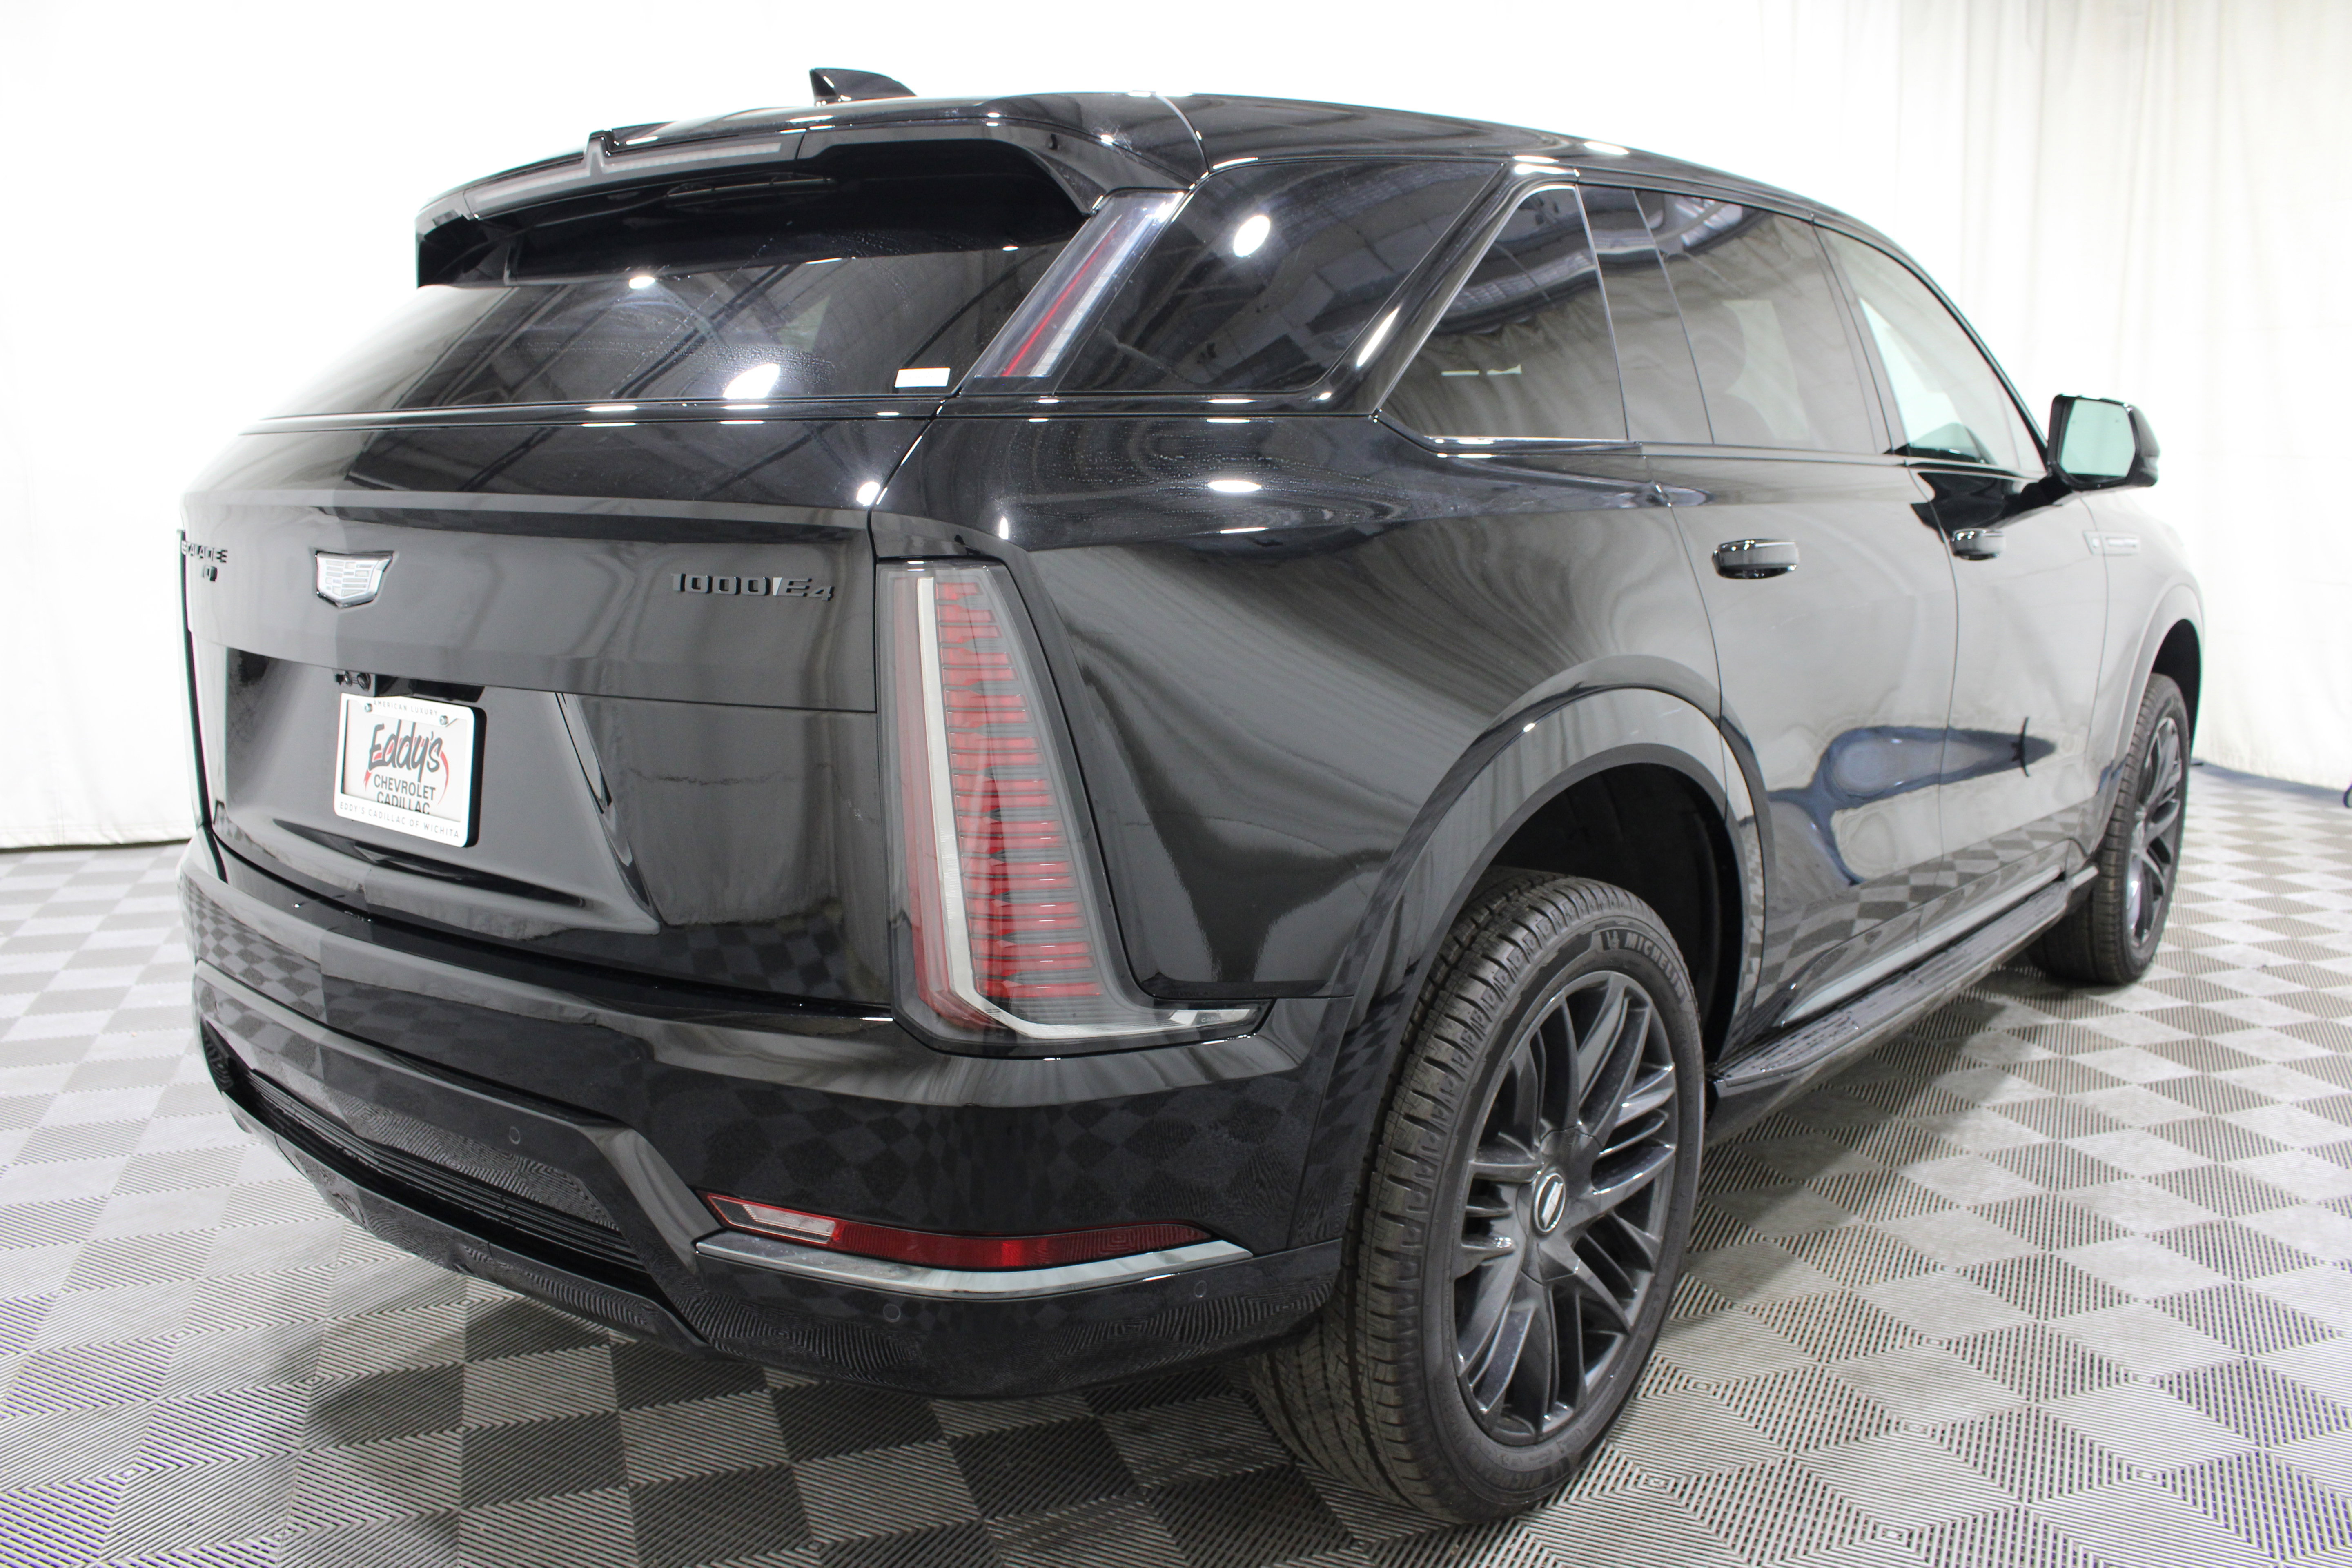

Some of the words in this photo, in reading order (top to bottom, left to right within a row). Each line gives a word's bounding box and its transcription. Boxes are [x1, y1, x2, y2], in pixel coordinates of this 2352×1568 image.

[374, 700, 407, 711] AMERICAN
[411, 706, 438, 716] LUXURY
[368, 719, 443, 782] Eddy's
[374, 774, 436, 800] CHEVROLET
[377, 791, 430, 814] CADILLAC
[340, 802, 365, 815] EDDY'S
[368, 808, 405, 825] CADILLAC
[410, 819, 419, 828] OF
[424, 822, 459, 838] WICHITA
[1625, 932, 1685, 999] MICHELIN
